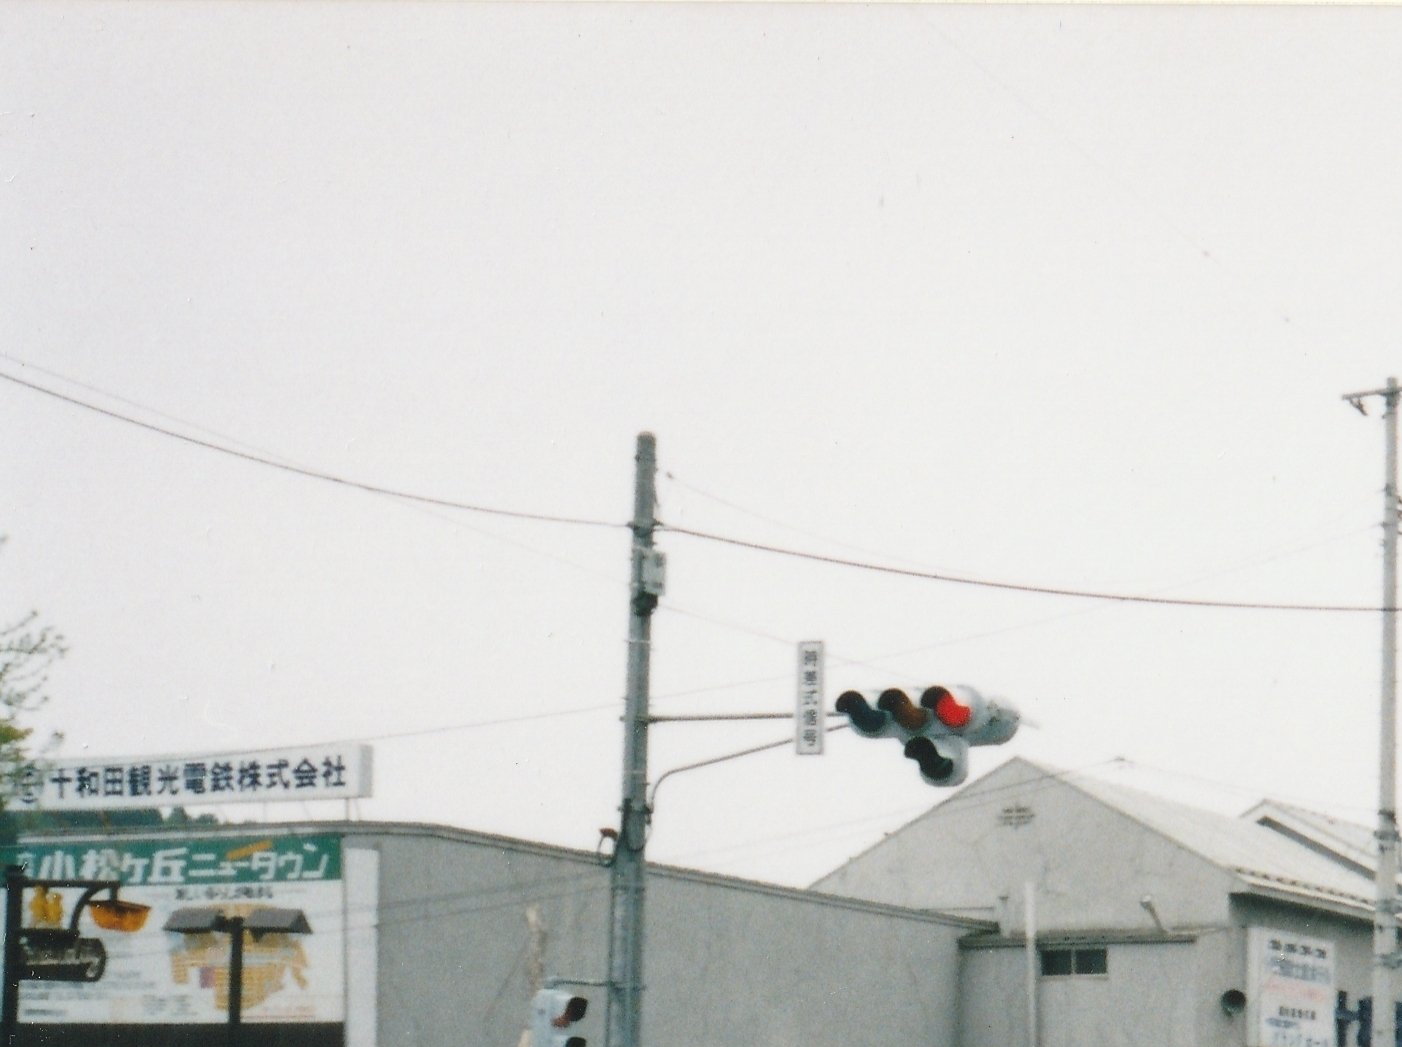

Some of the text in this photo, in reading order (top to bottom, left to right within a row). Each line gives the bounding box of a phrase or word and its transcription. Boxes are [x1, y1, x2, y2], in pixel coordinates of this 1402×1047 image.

[51, 755, 347, 798] 十和田観光電鉄株式会社
